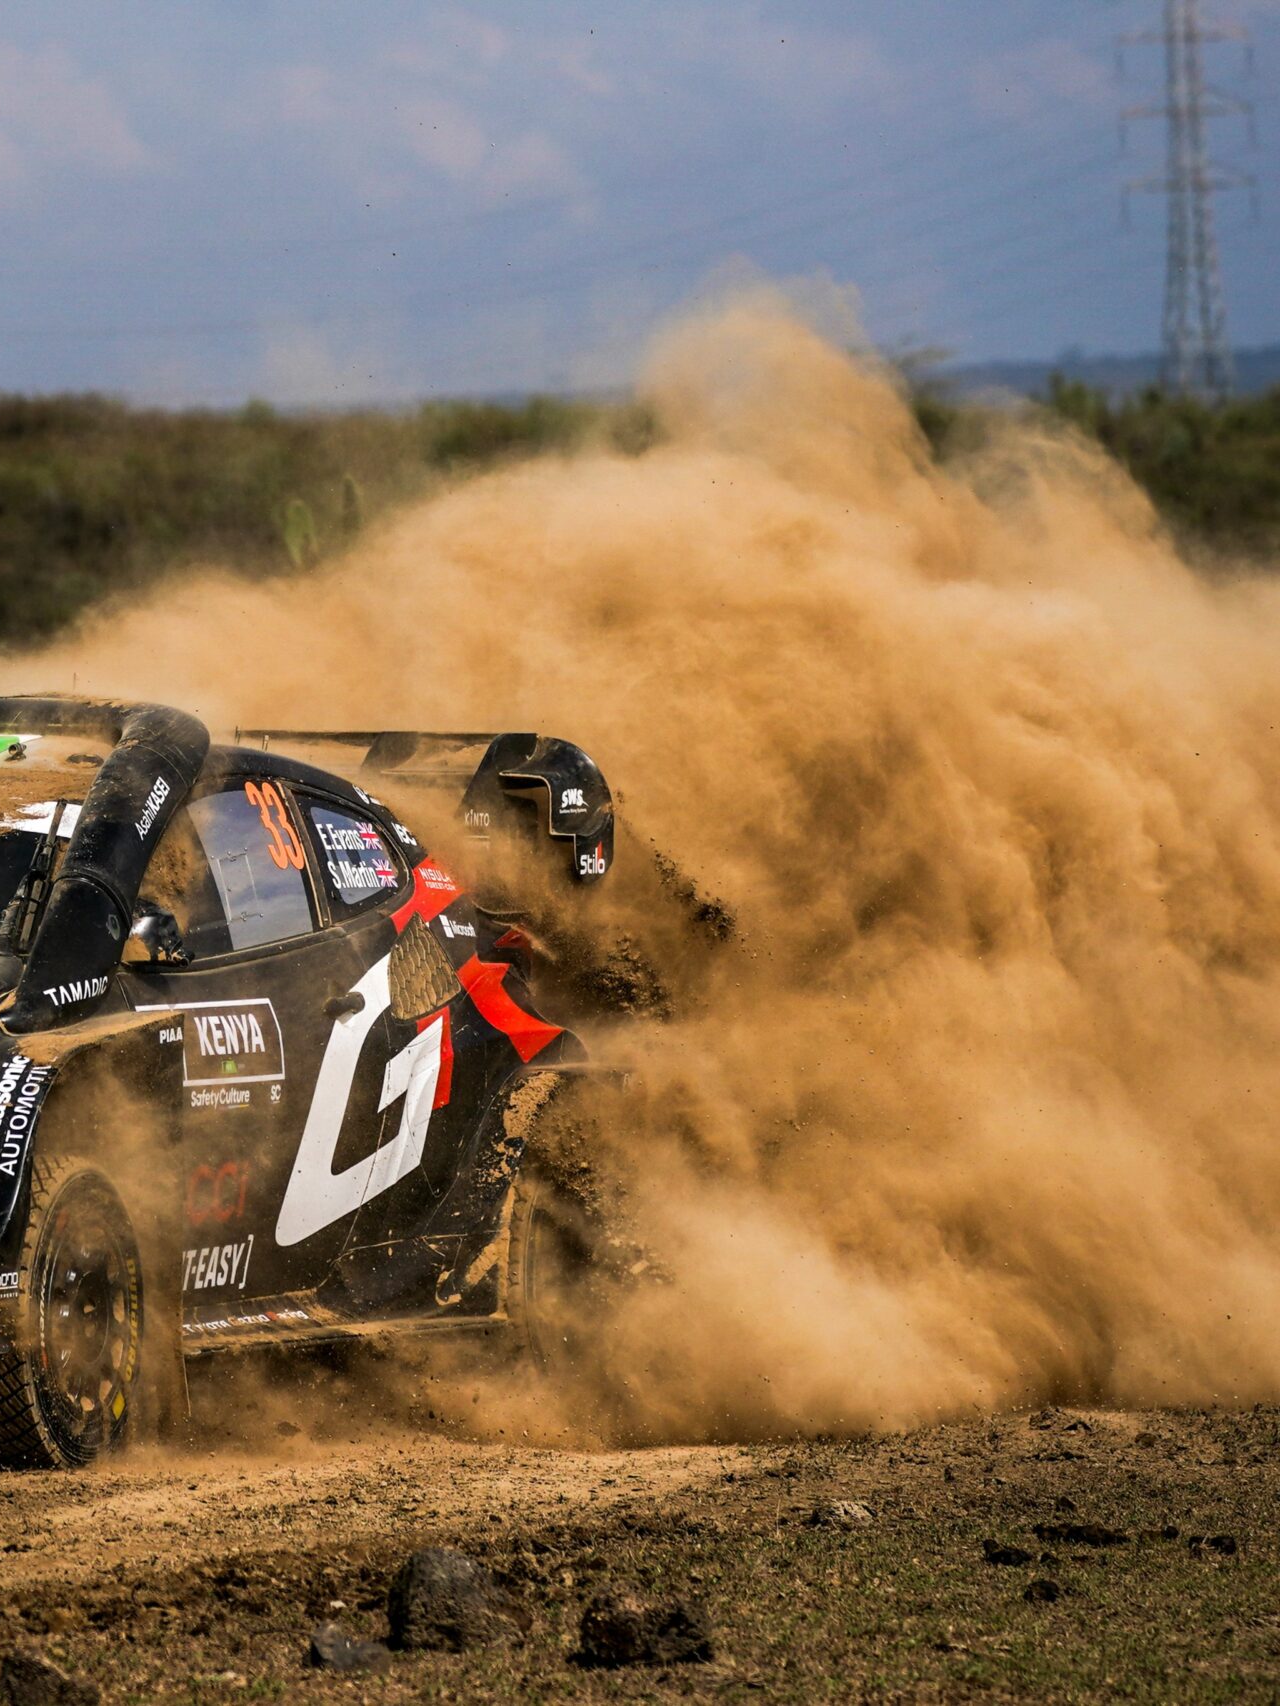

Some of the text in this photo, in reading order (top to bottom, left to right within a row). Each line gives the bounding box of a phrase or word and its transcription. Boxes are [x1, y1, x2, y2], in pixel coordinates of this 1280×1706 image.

[134, 776, 171, 840] AsahiKASEI
[561, 788, 584, 808] SWS
[244, 781, 305, 870] 33
[315, 823, 365, 851] E.Evans
[580, 841, 606, 875] Stilo
[328, 862, 381, 889] S.Martin
[449, 919, 478, 938] Microsoft
[43, 975, 109, 1007] TAMADIC
[159, 1027, 183, 1044] PIAA
[194, 1013, 266, 1057] KENYA
[191, 1087, 250, 1109] SafetyCulture
[270, 1084, 282, 1101] SC
